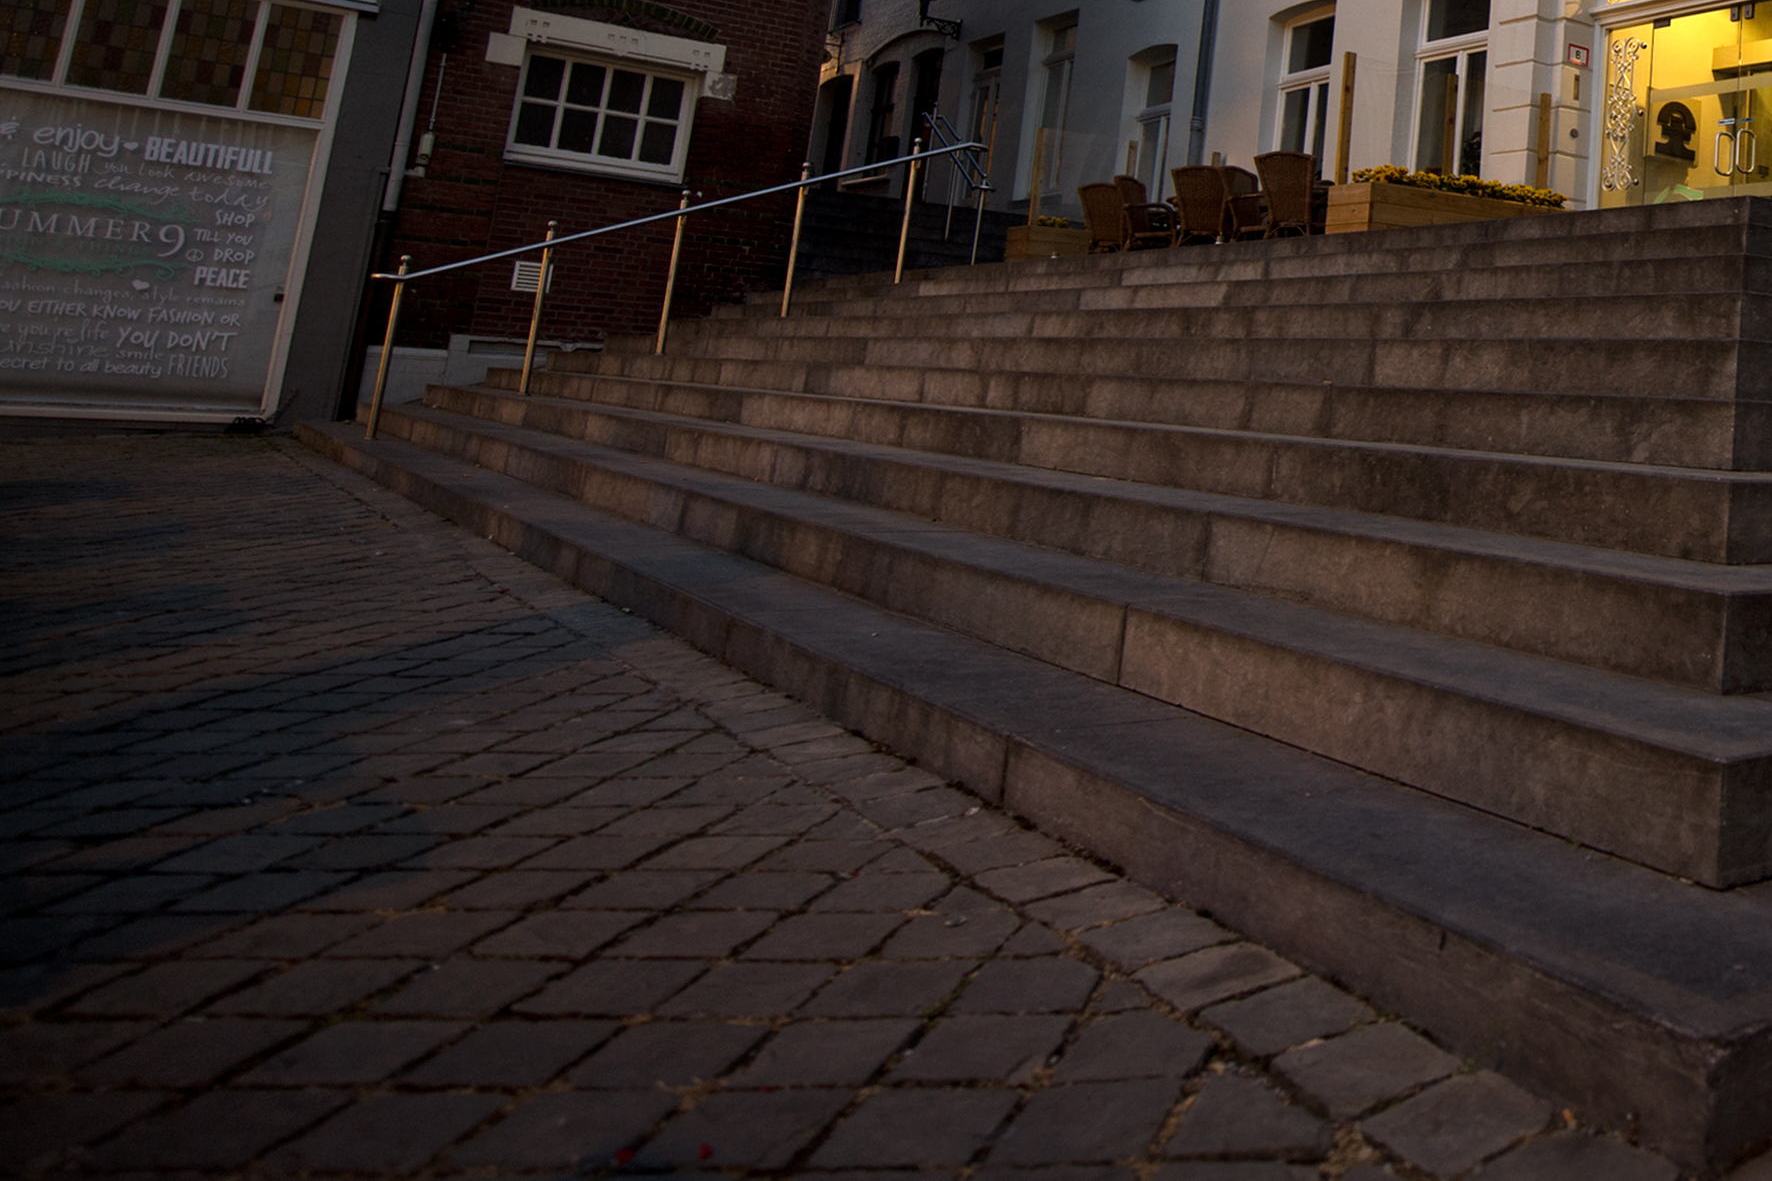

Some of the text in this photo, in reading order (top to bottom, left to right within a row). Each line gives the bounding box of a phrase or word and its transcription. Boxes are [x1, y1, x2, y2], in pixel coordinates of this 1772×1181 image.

[22, 147, 91, 174] LAUGH
[33, 123, 120, 157] enjoy
[144, 136, 273, 174] BEAUTIFULL
[94, 176, 180, 205] change
[189, 186, 271, 212] today
[215, 209, 255, 228] SHOP
[193, 228, 253, 246] TILL YOU
[213, 248, 255, 265] DROP
[193, 266, 251, 289] PEACE
[0, 275, 55, 292] ashion
[141, 284, 180, 306] style
[186, 295, 246, 307] remains
[27, 299, 87, 317] EITHER
[92, 304, 142, 320] KNOW
[148, 306, 215, 326] FASHION
[220, 313, 241, 327] OR
[80, 318, 111, 341] life
[116, 326, 160, 348] YOU
[166, 330, 238, 352] DON'T
[115, 343, 163, 360] smile
[57, 357, 75, 372] to
[80, 358, 100, 372] all
[104, 360, 162, 379] beauty
[167, 353, 228, 379] FRIENDS
